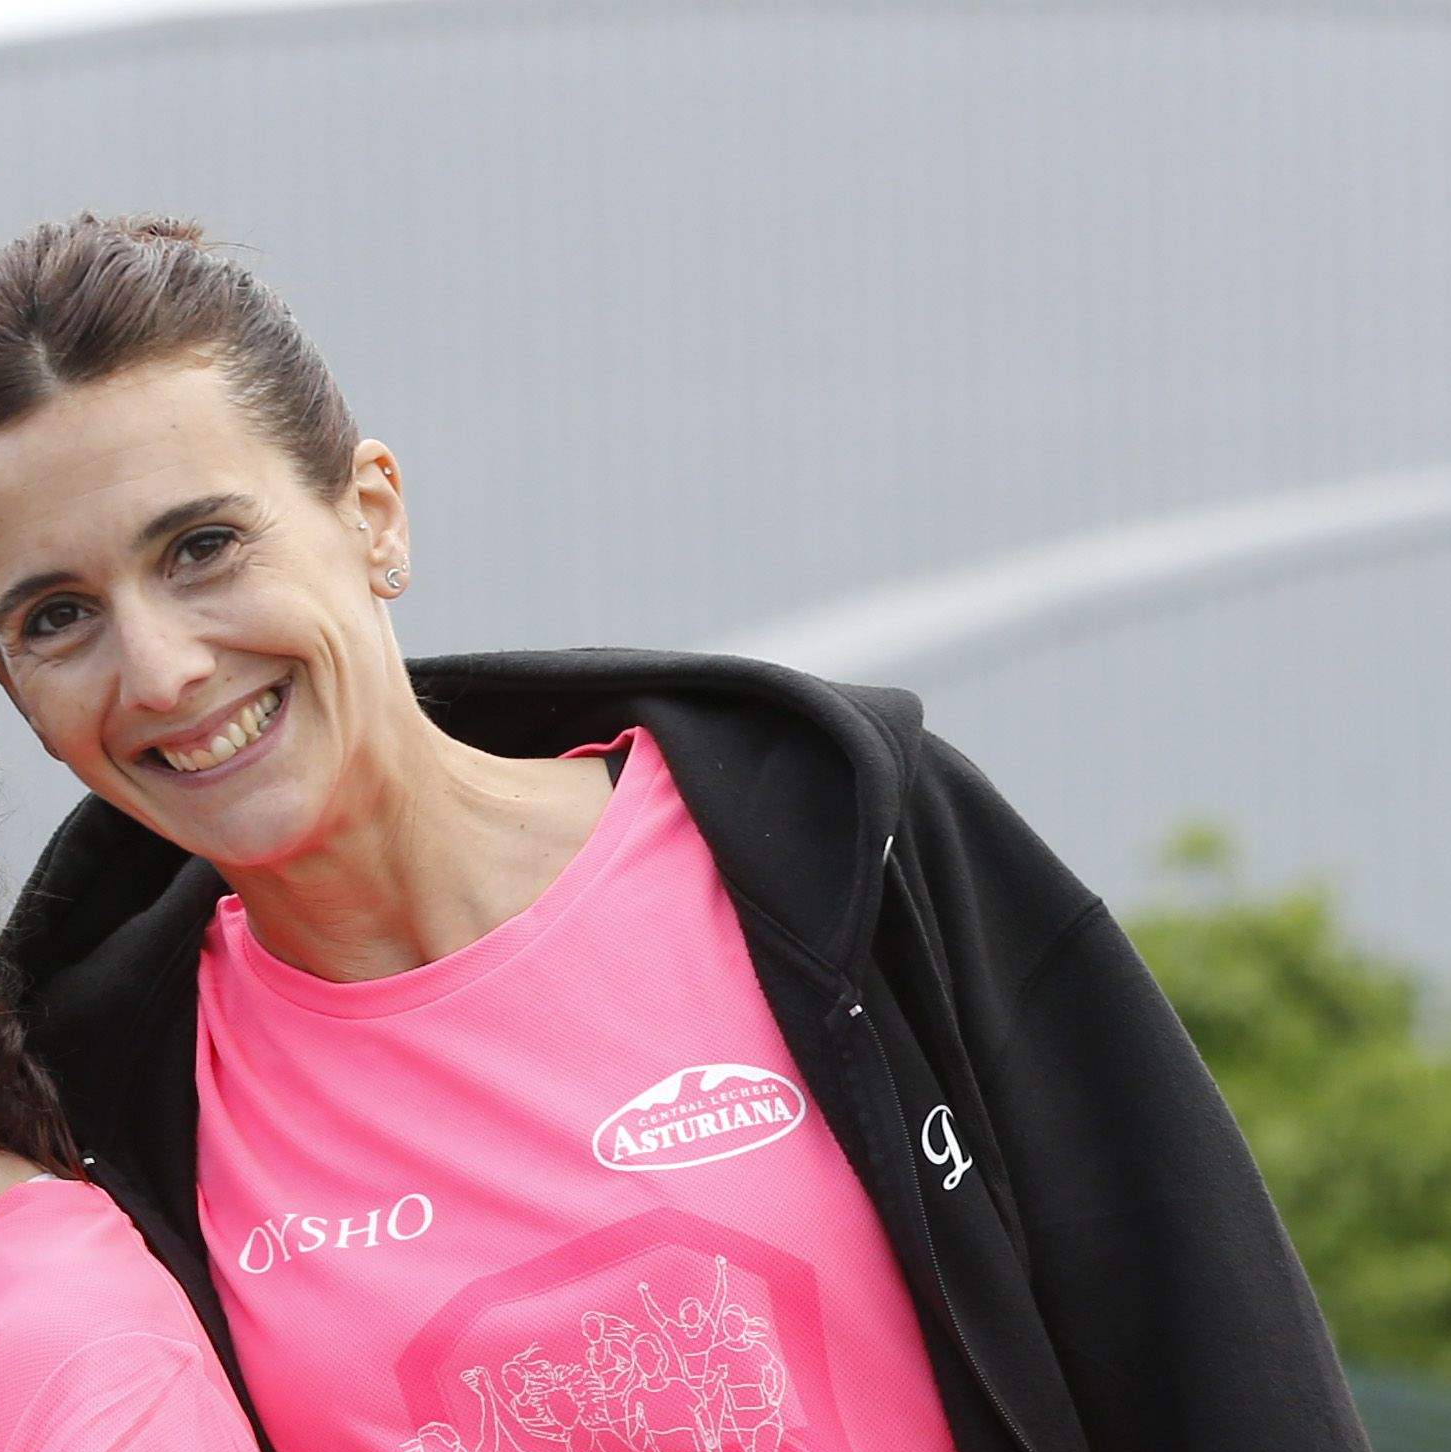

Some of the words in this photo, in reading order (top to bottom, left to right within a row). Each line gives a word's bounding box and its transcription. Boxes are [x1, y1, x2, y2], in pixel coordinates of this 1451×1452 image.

[612, 1096, 794, 1162] ASTURIANA
[638, 1100, 706, 1128] CENTRAL
[708, 1083, 780, 1106] LECHERA
[238, 1193, 434, 1274] OYSHO
